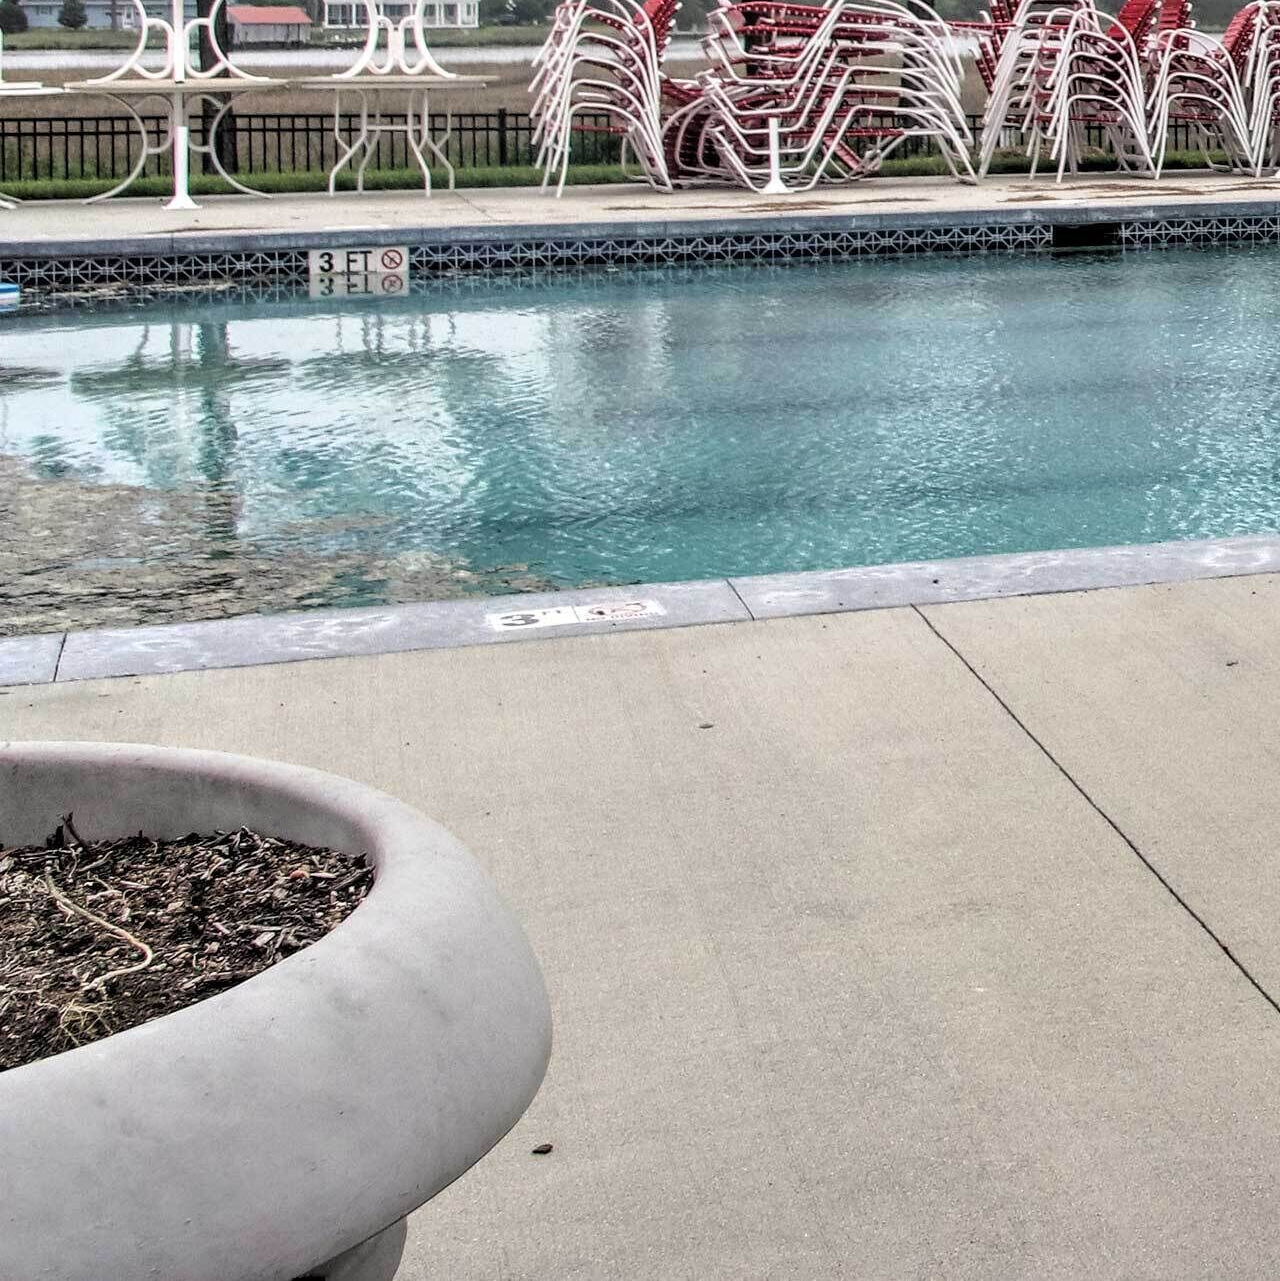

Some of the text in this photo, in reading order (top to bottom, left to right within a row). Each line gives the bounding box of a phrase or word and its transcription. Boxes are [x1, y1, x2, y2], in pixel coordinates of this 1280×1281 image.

[319, 250, 372, 273] 3 FT
[500, 614, 539, 626] 3
